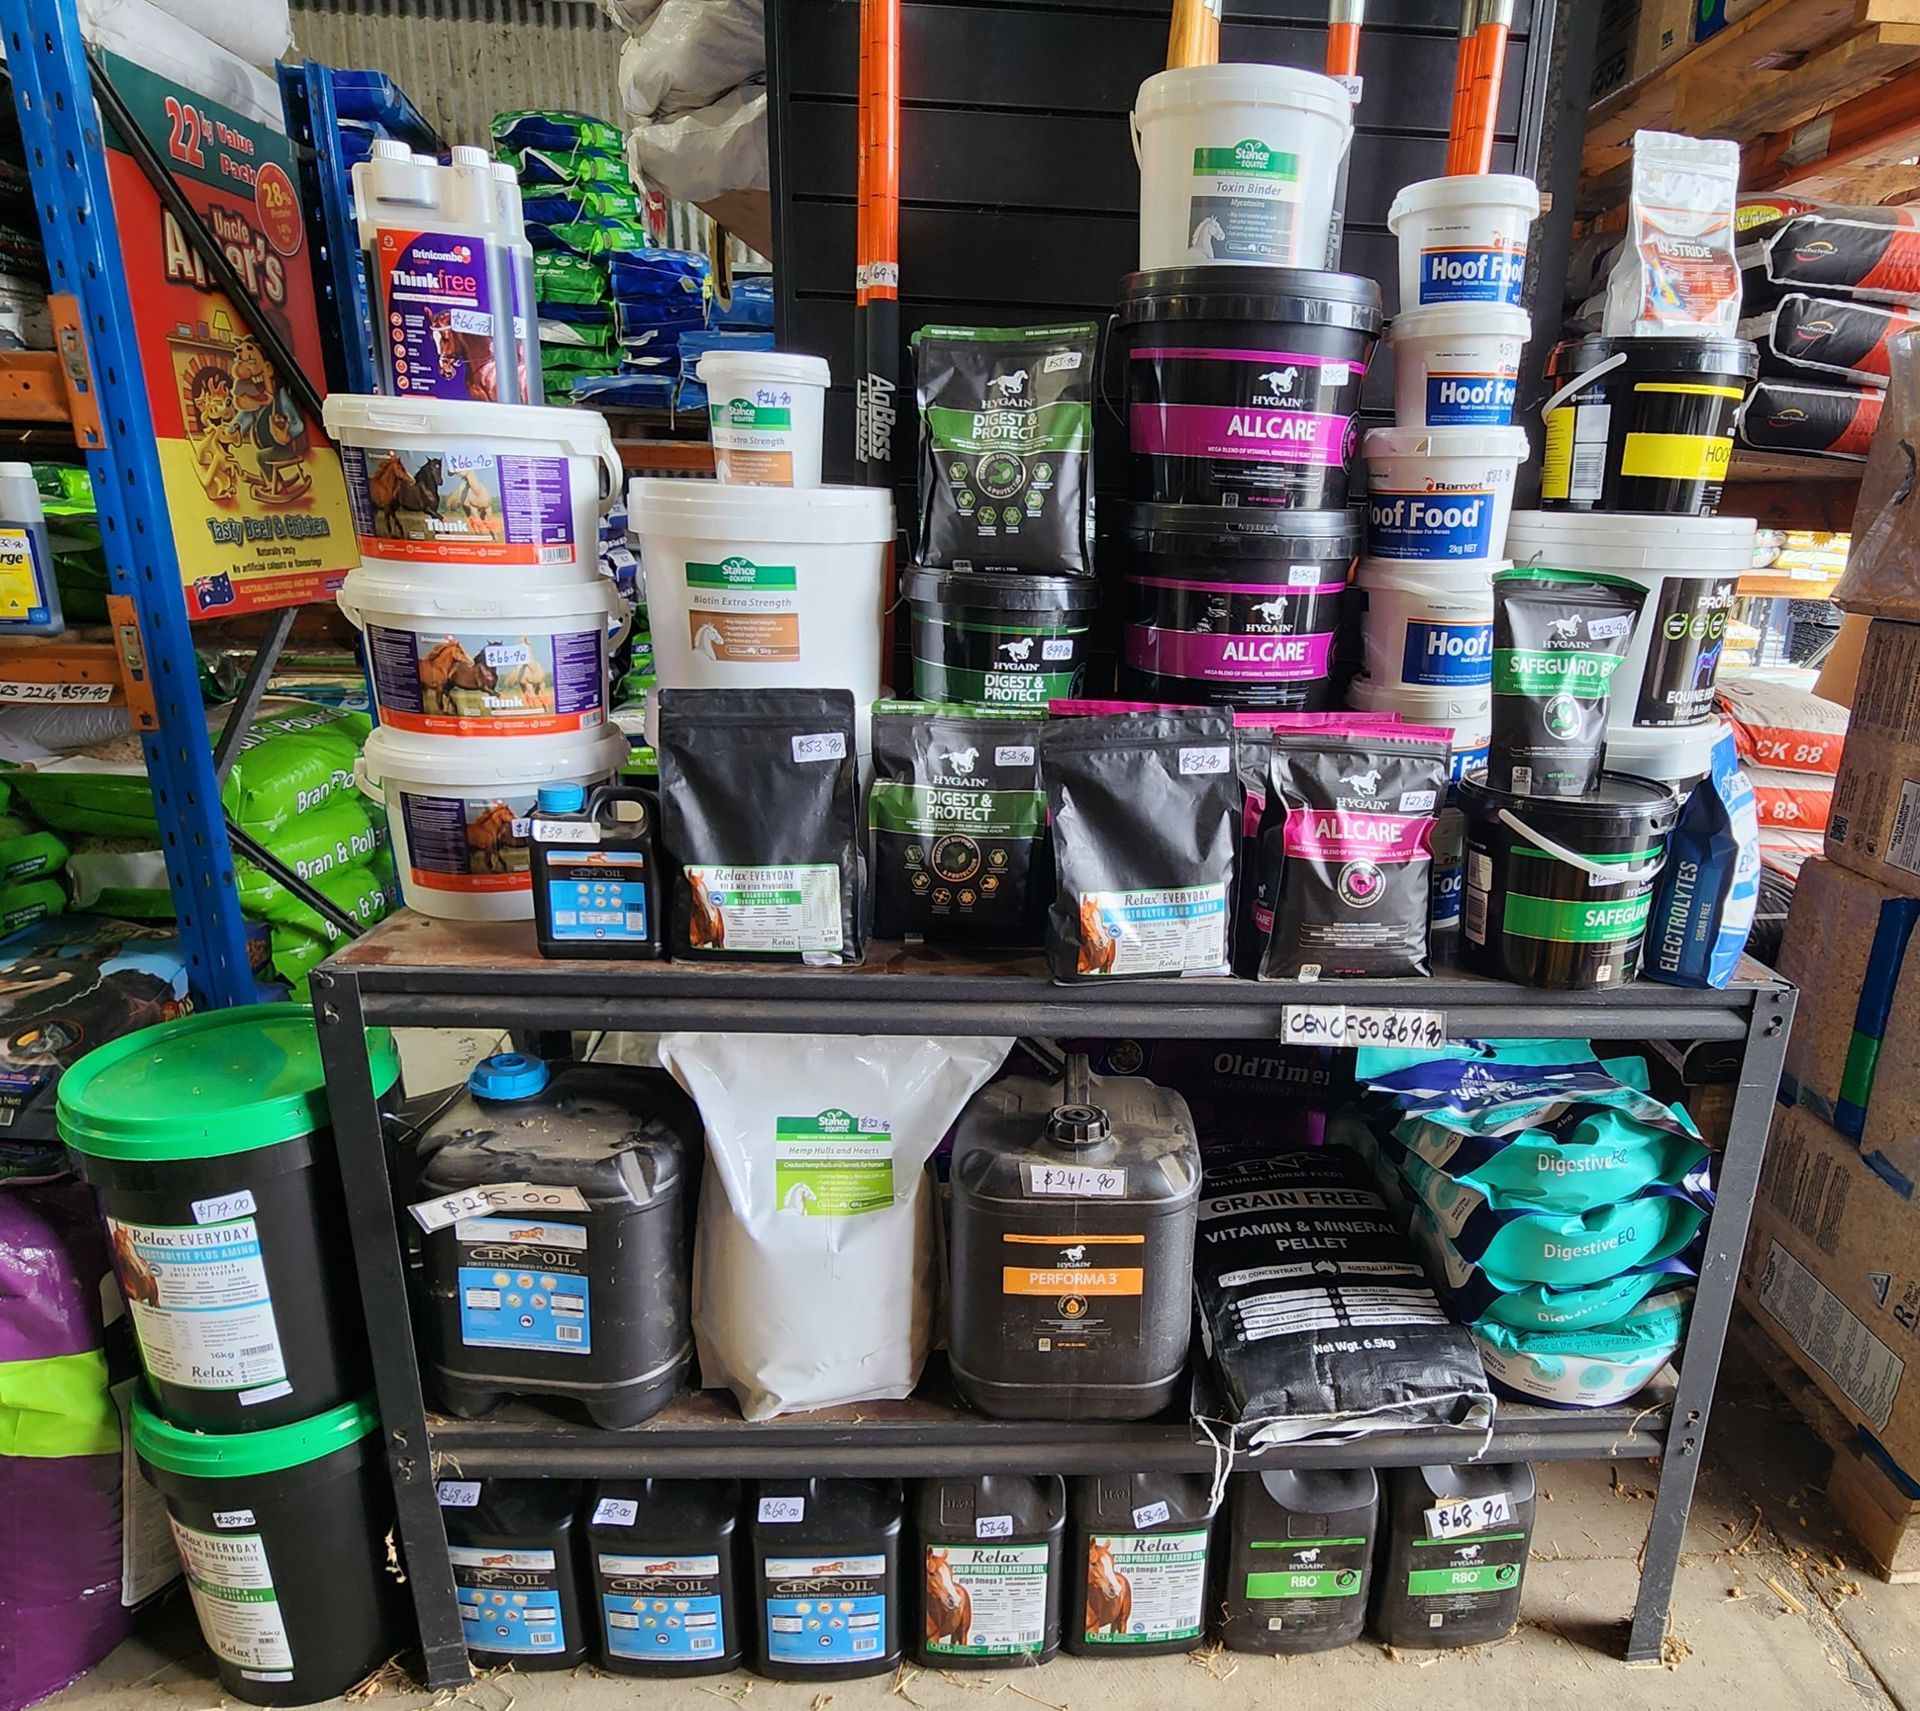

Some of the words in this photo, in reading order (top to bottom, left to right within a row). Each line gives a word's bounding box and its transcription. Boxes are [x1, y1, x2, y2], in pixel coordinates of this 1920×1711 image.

[216, 121, 255, 156] Value
[1235, 148, 1269, 161] Stance
[219, 153, 258, 187] Pack
[1241, 161, 1268, 169] EQUITEC
[1216, 182, 1245, 193] Toxin
[1247, 184, 1282, 196] Binder
[1230, 198, 1266, 208] Mycotoxins
[213, 210, 250, 243] Uncle
[412, 249, 464, 263] Brinicombe
[1658, 241, 1712, 258] IN-STRIDE
[1432, 255, 1488, 280] Hoof
[1490, 257, 1524, 282] Food
[390, 269, 477, 291] Thinkfree
[1440, 381, 1494, 404] Hoof
[981, 399, 1034, 410] HYGAIN
[1252, 395, 1301, 407] HYGAIN
[728, 406, 755, 416] Stance
[868, 373, 896, 462] AgBoss
[973, 413, 1025, 427] DIGEST
[1027, 412, 1038, 425] &
[972, 425, 1036, 439] PROTECT
[1227, 415, 1316, 441] ALLCARE
[730, 432, 748, 444] Extra
[750, 435, 785, 446] Strength
[1435, 482, 1483, 491] Ranvet
[1370, 500, 1405, 527] oof
[1409, 501, 1480, 527] Food
[208, 518, 241, 546] Tasty
[245, 517, 272, 541] Beef
[272, 516, 285, 538] &
[285, 515, 329, 539] Chicken
[424, 519, 468, 532] Think
[1449, 545, 1463, 555] 2kg
[1464, 544, 1478, 553] NET
[722, 565, 756, 575] Stance
[693, 594, 720, 605] Biotin
[721, 597, 747, 607] Extra
[749, 598, 792, 609] Strength
[1246, 624, 1292, 633] HYGAIN
[1428, 630, 1489, 656] Hoof
[1543, 641, 1589, 649] HYGAIN
[1222, 641, 1306, 661] ALLCARE
[993, 661, 1039, 671] HYGAIN
[1510, 655, 1598, 676] SAFEGUARD
[984, 675, 1033, 689] DIGEST
[1034, 676, 1045, 688] &
[483, 695, 523, 709] Think
[983, 688, 1044, 702] PROTECT
[1666, 689, 1704, 705] EQUINE
[1793, 743, 1824, 764] 88
[933, 775, 986, 787] HYGAIN
[297, 783, 330, 814] Bran
[927, 792, 976, 806] DIGEST
[980, 793, 993, 806] &
[1336, 797, 1389, 810] HYGAIN
[926, 806, 990, 821] PROTECT
[1773, 802, 1799, 820] 88
[1315, 818, 1403, 843] ALLCARE
[296, 850, 334, 882] Bran
[337, 840, 350, 863] &
[604, 867, 625, 878] OIL
[714, 869, 747, 882] Relax
[750, 870, 794, 881] EVERYDAY
[1125, 893, 1159, 906] Relax
[1163, 890, 1210, 904] EVERYDAY
[1659, 859, 1699, 973] ELECTROLYTES
[1695, 918, 1706, 943] SUGAR
[1701, 902, 1712, 917] FREE
[771, 937, 796, 947] Relax
[818, 1116, 850, 1127] Stance
[788, 1146, 813, 1155] Hemp
[814, 1146, 835, 1155] Hulls
[837, 1146, 851, 1154] and
[852, 1146, 880, 1155] Hearts
[1210, 1177, 1265, 1188] NATURAL
[1268, 1171, 1306, 1180] HORSE
[1210, 1193, 1299, 1213] GRAIN
[1305, 1191, 1374, 1206] FREE
[133, 1229, 174, 1247] Relax
[180, 1226, 250, 1246] EVERYDAY
[1204, 1221, 1293, 1243] VITAMIN
[1296, 1221, 1311, 1233] &
[1314, 1221, 1400, 1235] MINERAL
[1275, 1237, 1348, 1251] PELLET
[1544, 1226, 1637, 1261] DigestiveEQ
[138, 1246, 191, 1262] ELECTROLYTE
[194, 1247, 219, 1260] PLUS
[221, 1244, 256, 1257] AMINO
[470, 1248, 520, 1262] CEN
[542, 1252, 577, 1267] OIL
[1248, 1266, 1305, 1279] CONCENTRATE
[1347, 1264, 1396, 1273] AUSTRALIAN
[1029, 1272, 1107, 1285] PERFORMA
[1108, 1272, 1118, 1285] 3
[1314, 1343, 1334, 1355] Net
[1335, 1341, 1362, 1353] Wgt.
[1364, 1337, 1396, 1350] 6.5kg
[1526, 1340, 1549, 1351] whole
[1550, 1338, 1560, 1350] of
[1561, 1338, 1573, 1349] the
[1603, 1336, 1631, 1350] greater
[210, 1351, 236, 1361] 16kg
[191, 1365, 234, 1378] Relax
[204, 1540, 258, 1554] EVERYDAY
[1133, 1538, 1181, 1553] Relax
[971, 1549, 1021, 1564] Relax
[1114, 1554, 1130, 1563] COLD
[1131, 1553, 1160, 1563] PRESSED
[1162, 1553, 1192, 1563] FLAXSEED
[952, 1566, 969, 1574] COLD
[970, 1565, 999, 1575] PRESSED
[1000, 1565, 1032, 1574] FLAXSEED
[1135, 1566, 1158, 1574] Omega
[512, 1575, 545, 1586] OIL
[610, 1579, 655, 1591] CEN
[675, 1580, 708, 1591] OIL
[975, 1576, 998, 1586] Omega
[1290, 1575, 1317, 1588] RBO
[1452, 1573, 1478, 1585] RBO
[776, 1582, 821, 1593] CEN
[841, 1581, 874, 1592] OIL
[219, 1640, 251, 1659] Relax
